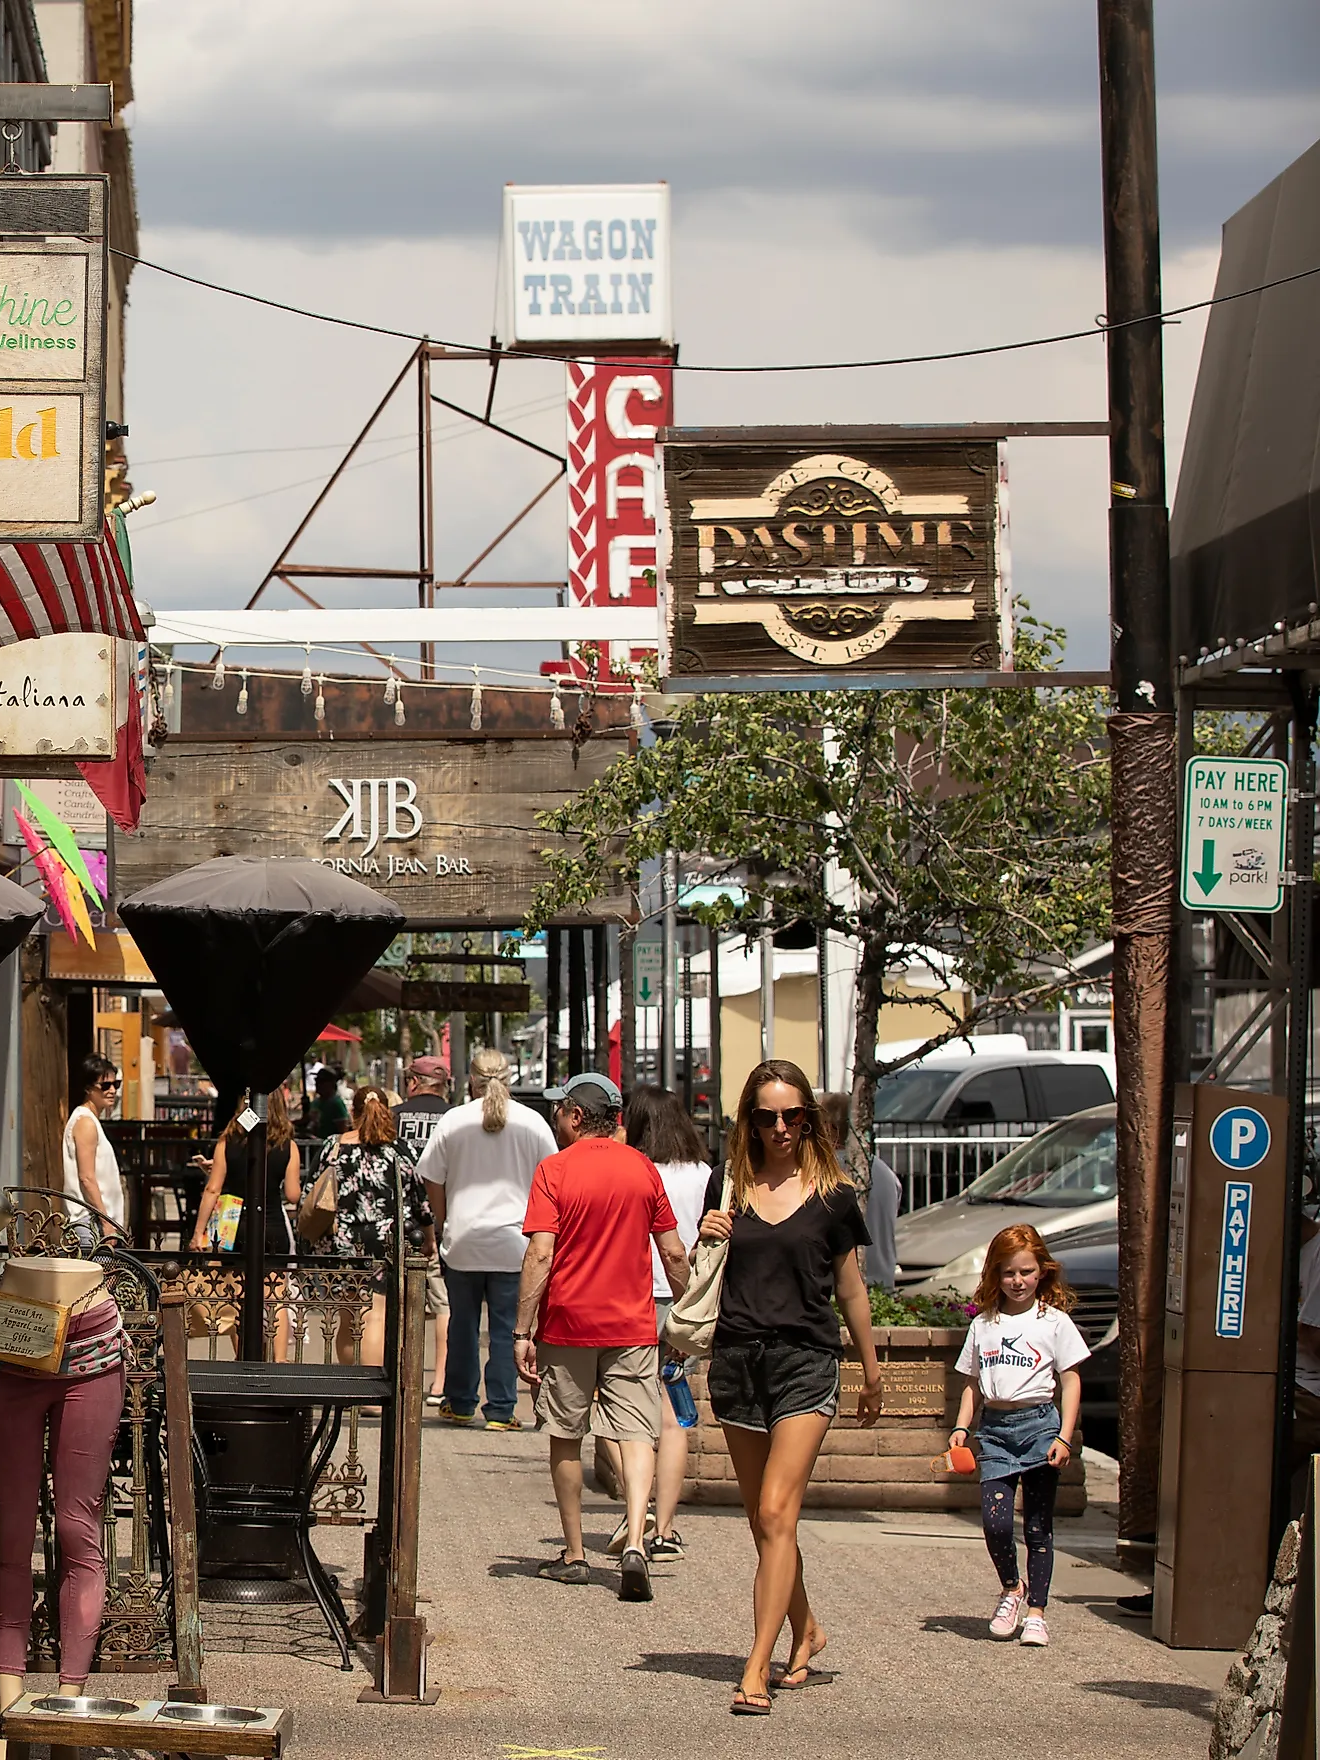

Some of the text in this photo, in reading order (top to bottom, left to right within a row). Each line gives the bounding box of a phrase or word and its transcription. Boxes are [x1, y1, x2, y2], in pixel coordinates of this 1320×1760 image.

[517, 218, 657, 261] WAGON
[524, 272, 653, 315] TRAIN
[692, 520, 976, 598] PASTIME
[1195, 770, 1279, 792] PAY HERE
[64, 789, 94, 799] Crafts
[63, 799, 96, 811] Candy
[1233, 800, 1243, 810] to
[63, 810, 104, 820] Sundries
[323, 777, 423, 858] KJB
[1198, 816, 1204, 827] 7
[387, 854, 429, 881] JEAN
[436, 855, 473, 876] BAR
[1230, 871, 1268, 885] park!
[1230, 1117, 1256, 1160] P
[1228, 1188, 1248, 1246] PAY
[1220, 1254, 1244, 1331] HERE
[9, 1305, 44, 1321] Local Art,
[33, 1324, 49, 1334] and
[12, 1332, 33, 1343] Gifts
[4, 1342, 35, 1356] Upstairs
[895, 1384, 945, 1393] ROESCHEN
[908, 1396, 928, 1405] 1992
